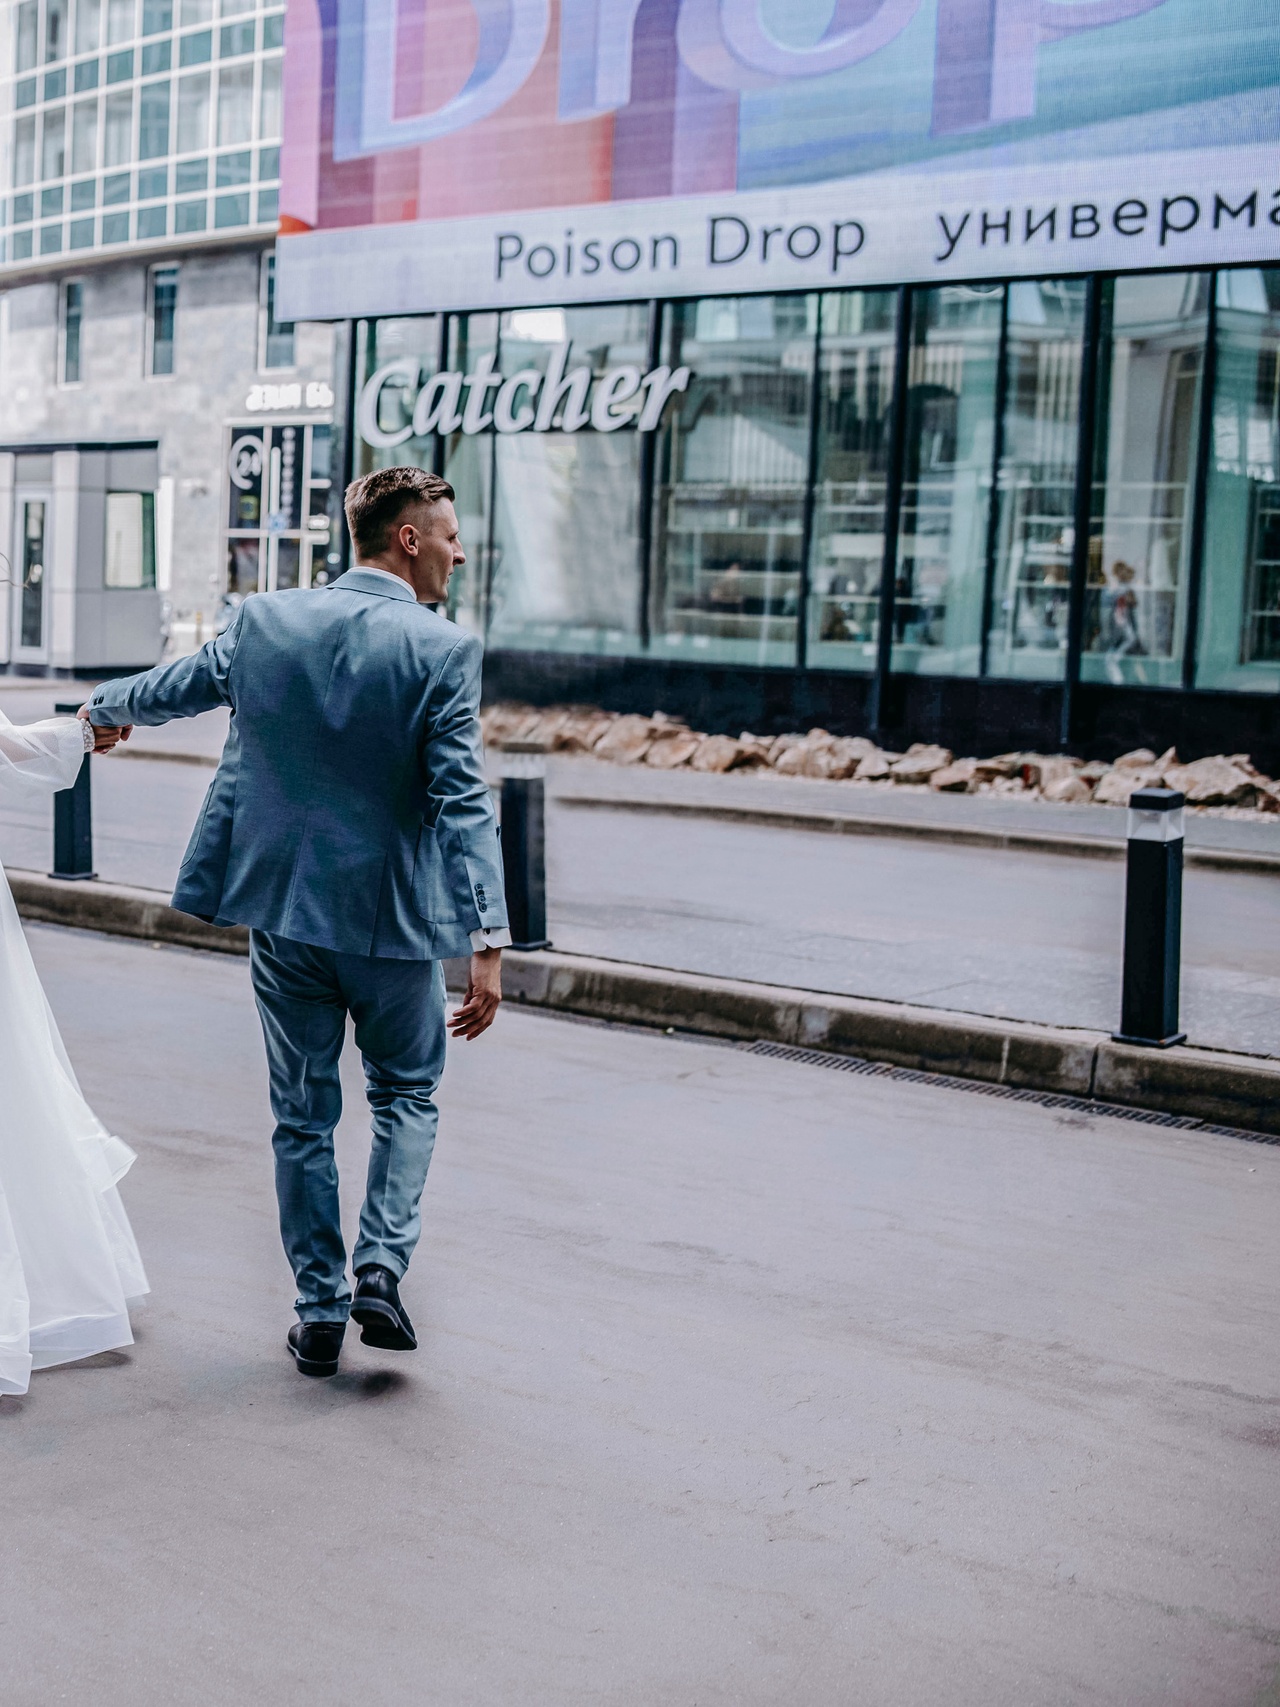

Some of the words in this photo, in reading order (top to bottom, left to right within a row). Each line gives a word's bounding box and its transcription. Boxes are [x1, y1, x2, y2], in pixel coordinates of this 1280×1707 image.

[496, 229, 680, 280] Poison
[707, 215, 866, 273] Drop
[357, 338, 694, 449] Catcher
